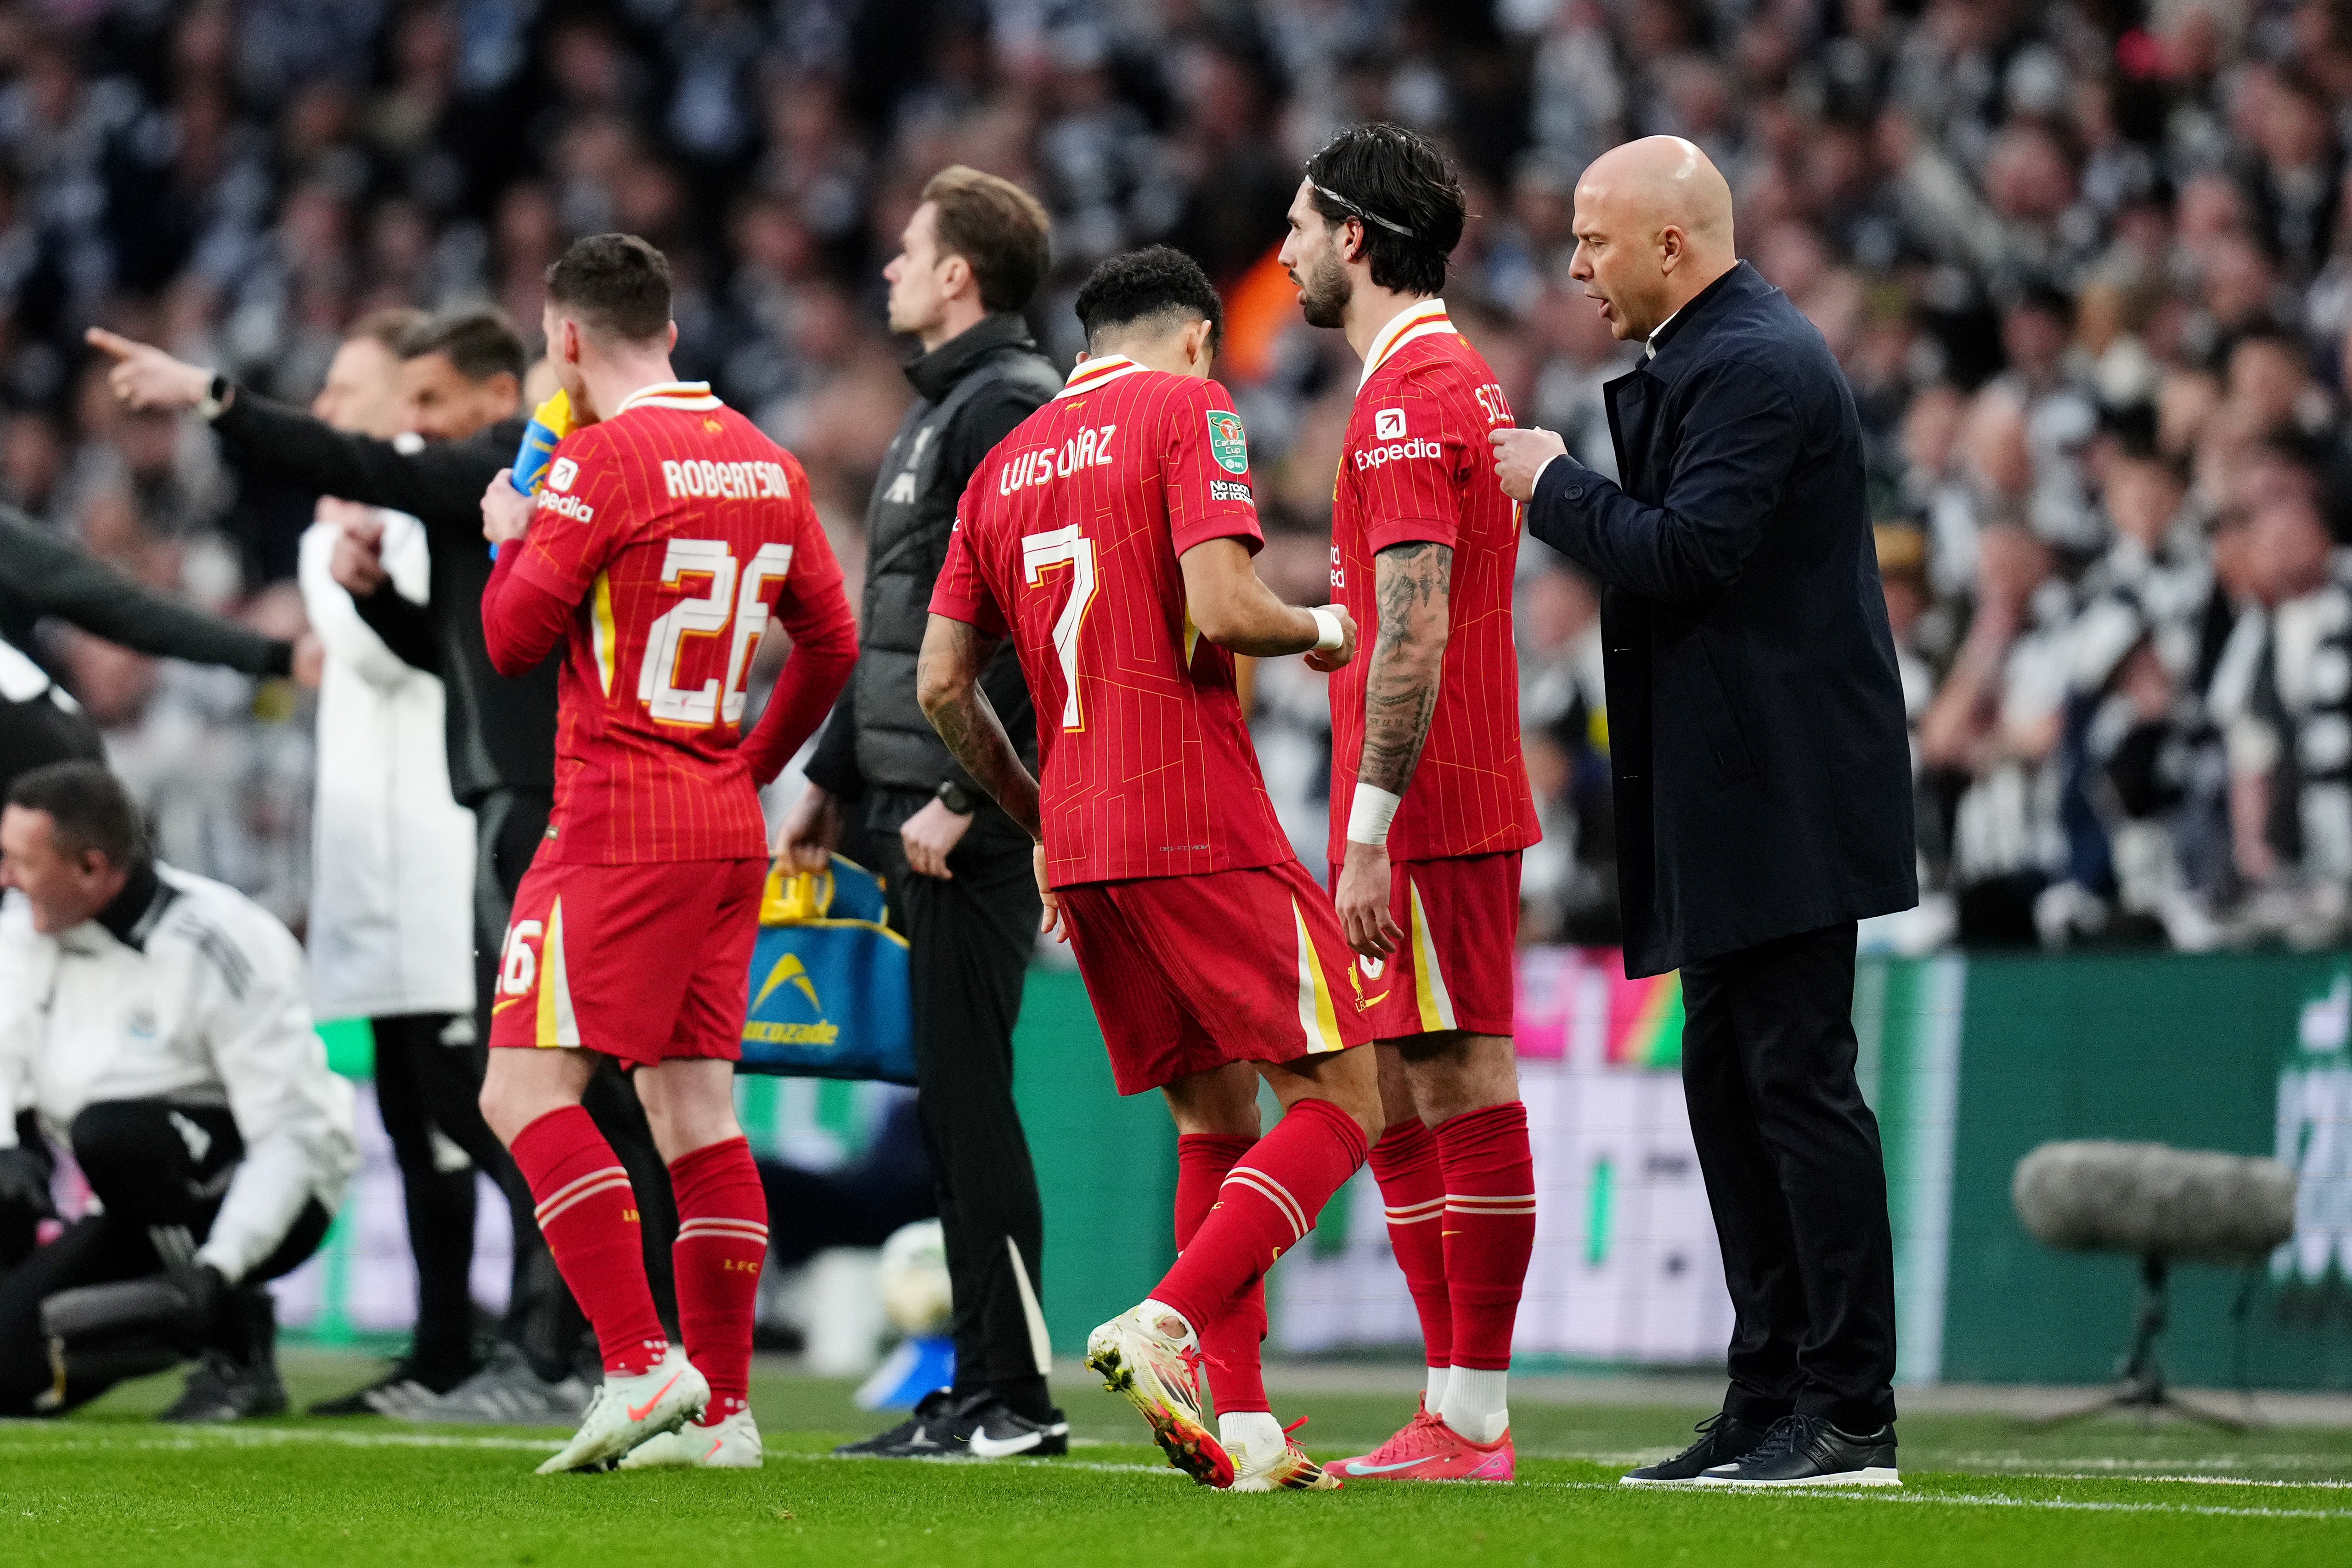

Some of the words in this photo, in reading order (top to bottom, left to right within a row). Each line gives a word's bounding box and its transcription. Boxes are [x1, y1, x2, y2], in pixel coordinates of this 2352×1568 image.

[1214, 439, 1244, 447] Carabao
[1355, 437, 1441, 472] Expedia
[1000, 448, 1056, 496] LUIS
[1210, 480, 1228, 491] No
[1229, 484, 1250, 497] room
[1211, 491, 1229, 501] for
[637, 537, 794, 729] 26
[1021, 523, 1100, 733] 7
[724, 1258, 759, 1275] LFC
